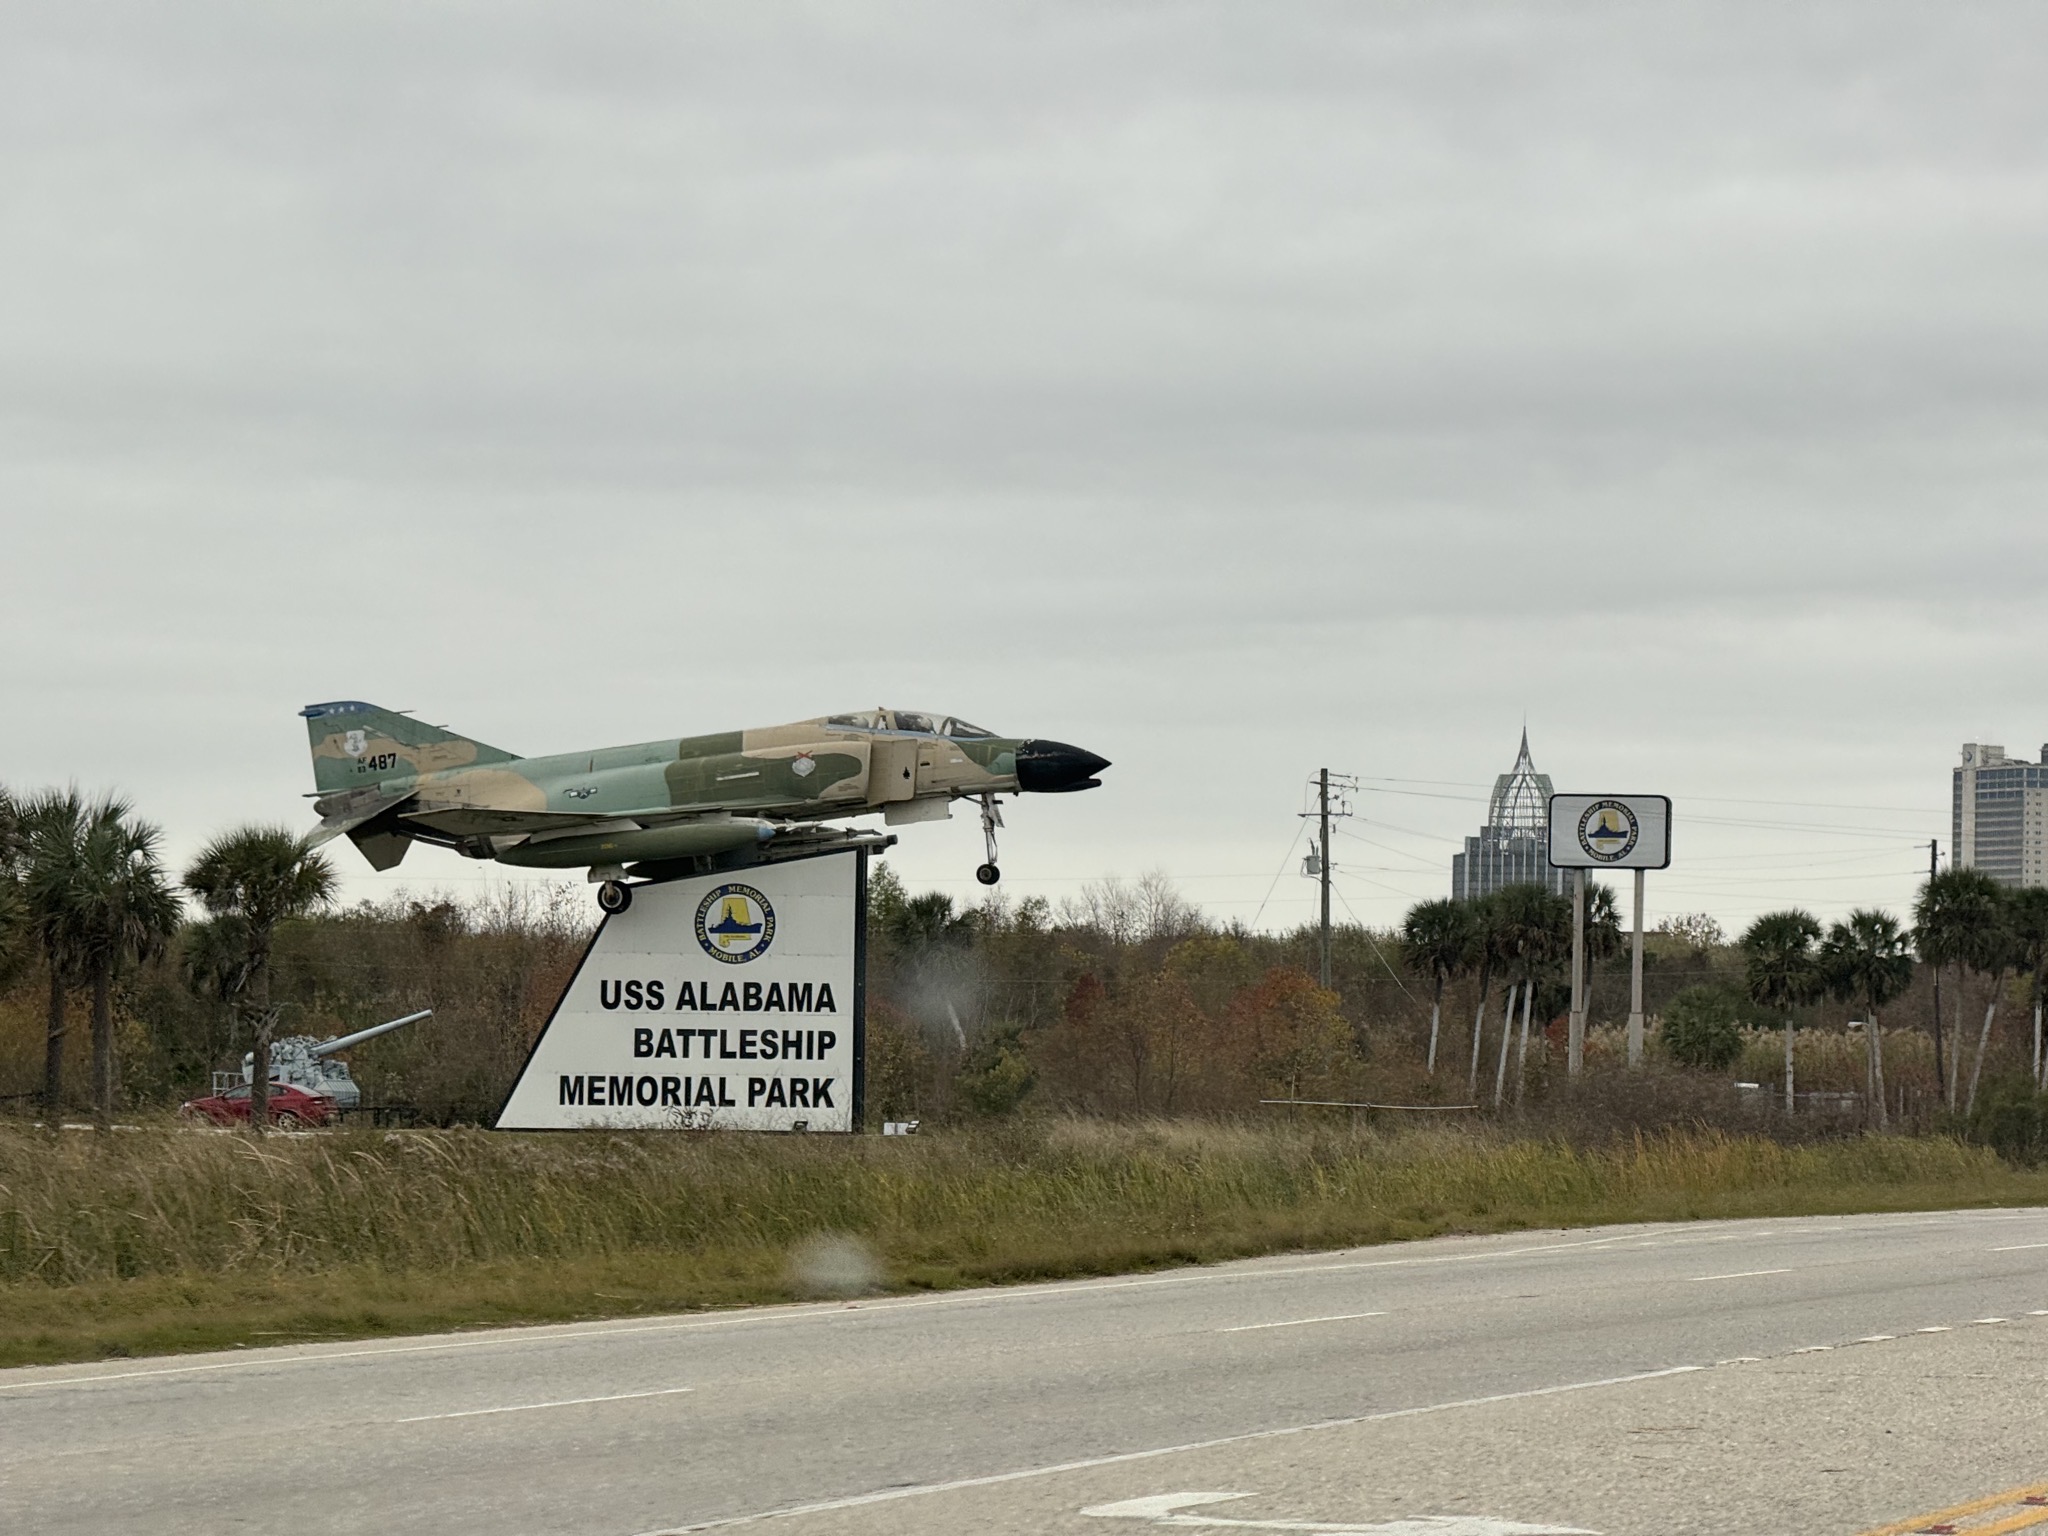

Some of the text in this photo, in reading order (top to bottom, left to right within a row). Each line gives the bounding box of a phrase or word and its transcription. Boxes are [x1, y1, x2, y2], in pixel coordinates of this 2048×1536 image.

[369, 752, 397, 771] 487
[1579, 801, 1638, 846] BATTLESHIP MEMORIAL PARK
[696, 885, 774, 942] BATTLESHIP MEMORIAL PARK
[708, 946, 761, 963] MOBILE, AL
[600, 979, 837, 1013] USS ALABAMA
[634, 1028, 837, 1061] BATTLESHIP
[559, 1075, 835, 1109] MEMORIAL PARK
